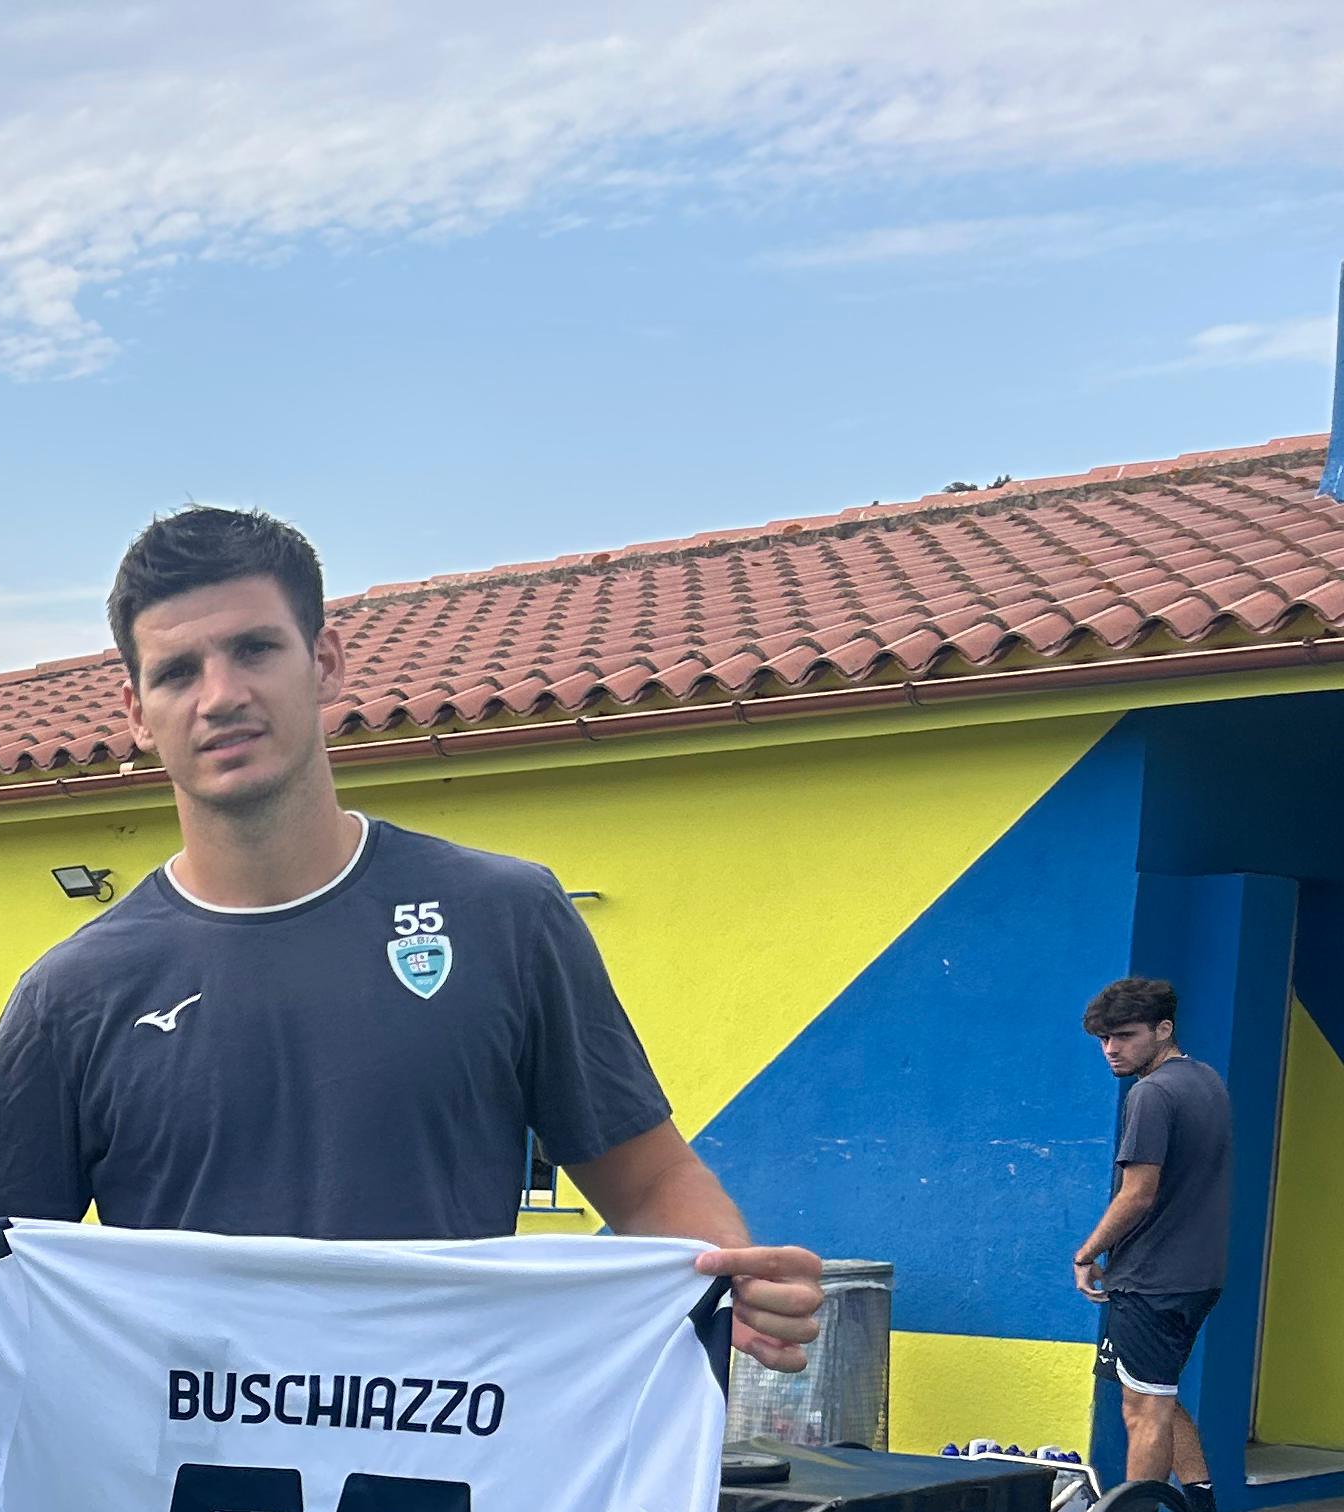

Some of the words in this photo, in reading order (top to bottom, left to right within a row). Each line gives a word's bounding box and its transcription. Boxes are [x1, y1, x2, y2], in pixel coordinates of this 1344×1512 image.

[394, 901, 444, 935] 55
[398, 936, 439, 948] OLBIA
[169, 1369, 506, 1437] BUSCHIAZZO
